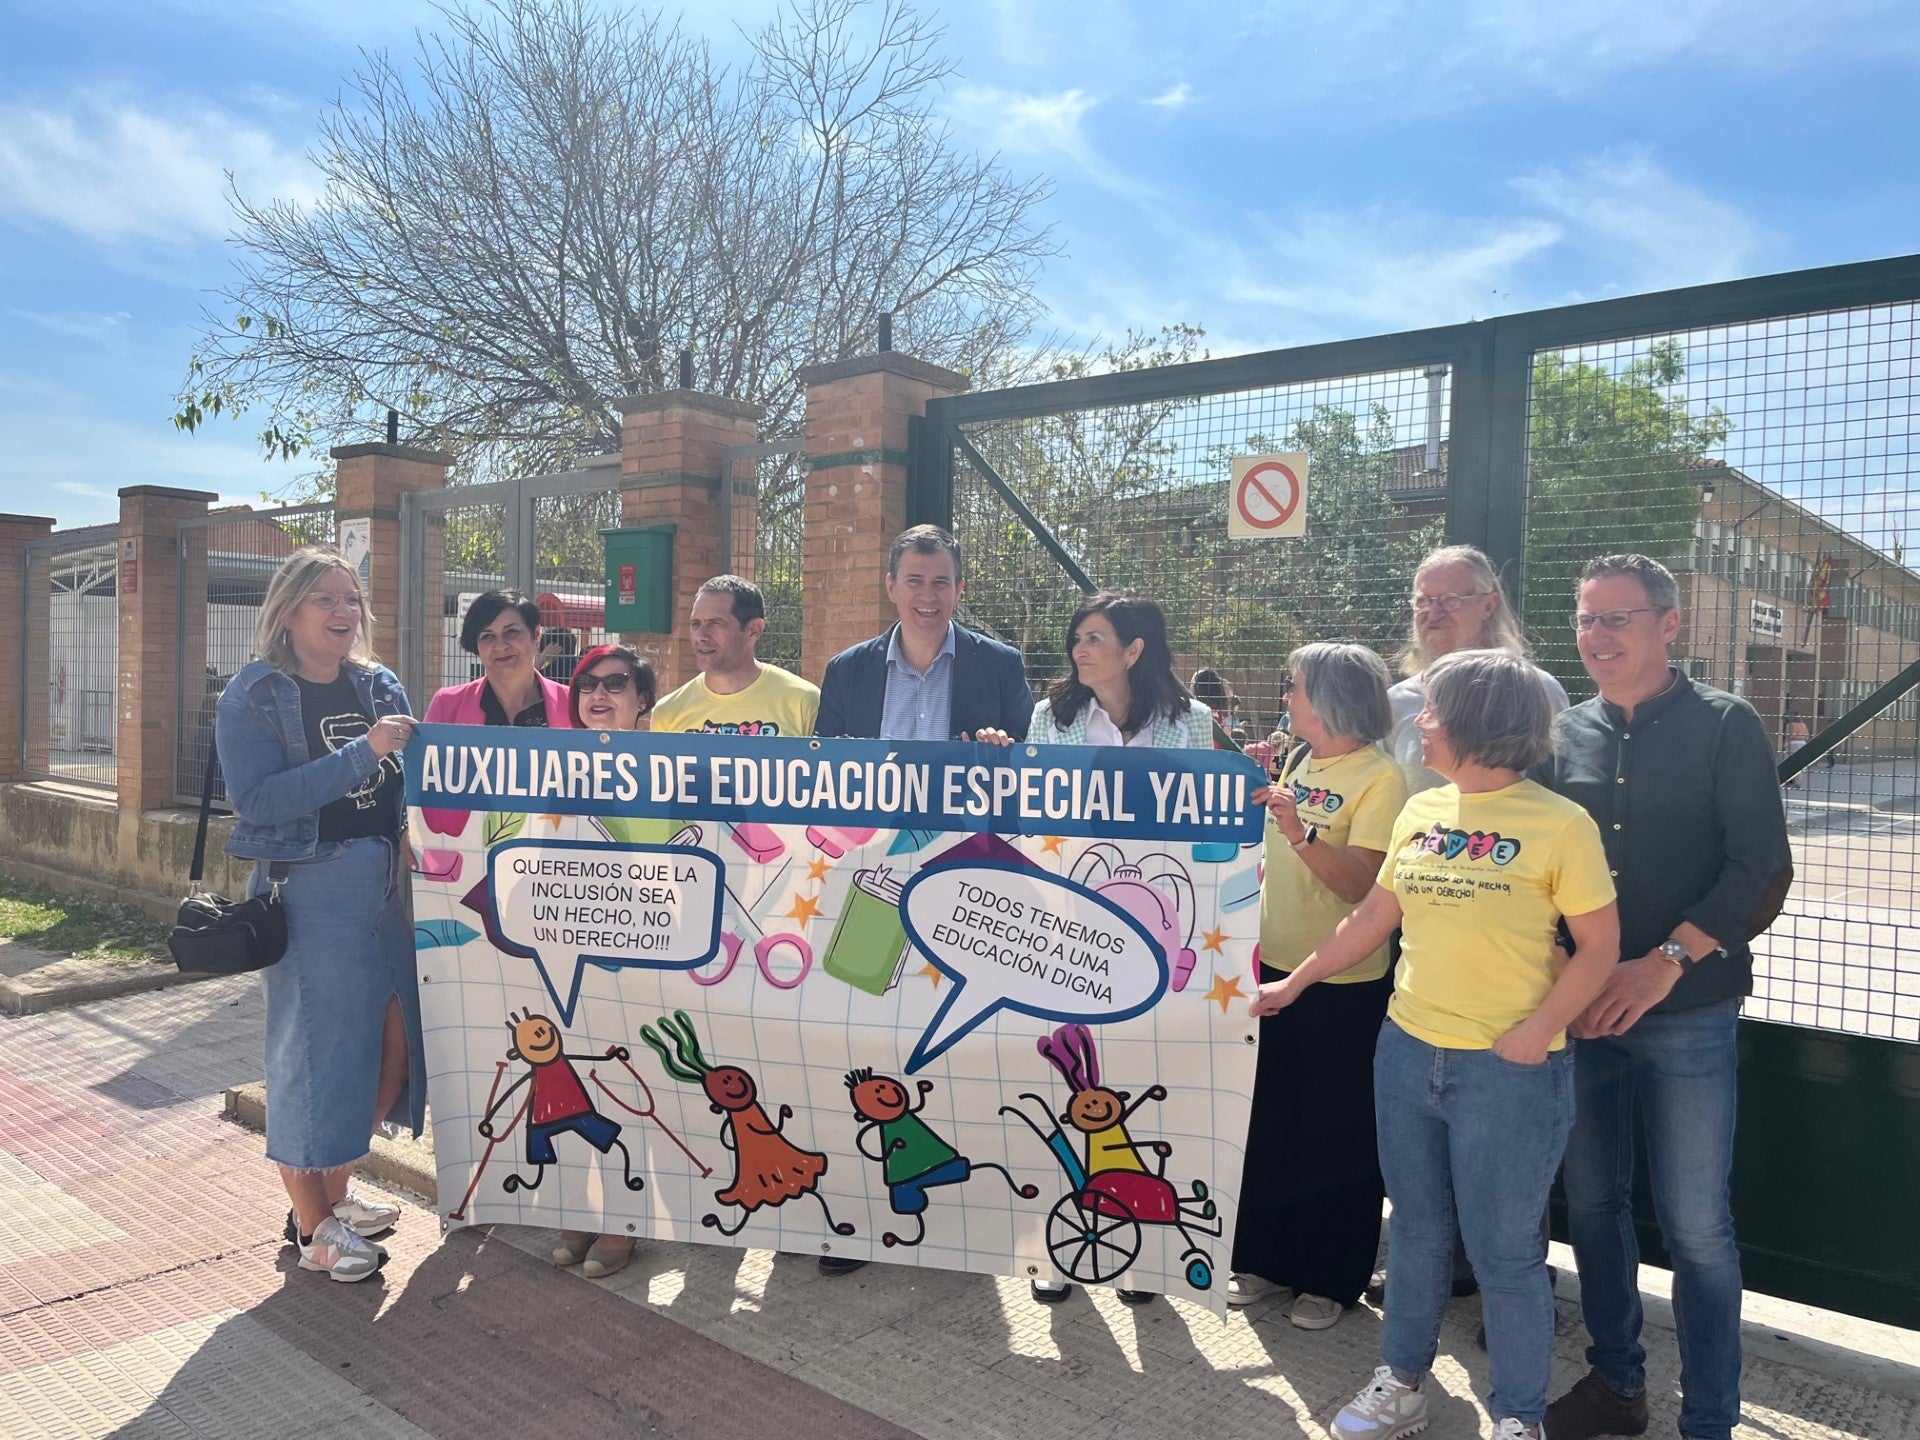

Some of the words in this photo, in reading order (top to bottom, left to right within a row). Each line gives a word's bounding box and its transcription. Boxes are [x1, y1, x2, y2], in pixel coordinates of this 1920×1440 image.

[422, 745, 639, 802] AUXILIARES
[649, 754, 698, 804] DE
[710, 752, 930, 814] EDUCACIÓN
[942, 765, 1135, 822] ESPECIAL
[1148, 771, 1246, 826] YA!!!
[513, 858, 622, 879] QUEREMOS
[628, 864, 668, 881] QUE
[674, 866, 698, 883] LA
[531, 881, 633, 903] INCLUSIÓN
[638, 887, 676, 904] SEA
[533, 905, 559, 921] UN
[565, 906, 636, 928] HECHO,
[643, 911, 671, 927] NO
[534, 926, 557, 943] UN
[562, 929, 671, 950] DERECHO!!!
[958, 881, 1025, 918] TODOS
[1030, 907, 1125, 954] TENEMOS
[932, 924, 1048, 980] EDUCACIÓN
[1051, 967, 1113, 1004] DIGNA
[951, 905, 1048, 952] DERECHO
[1049, 942, 1065, 960] A
[1069, 947, 1109, 977] UNA
